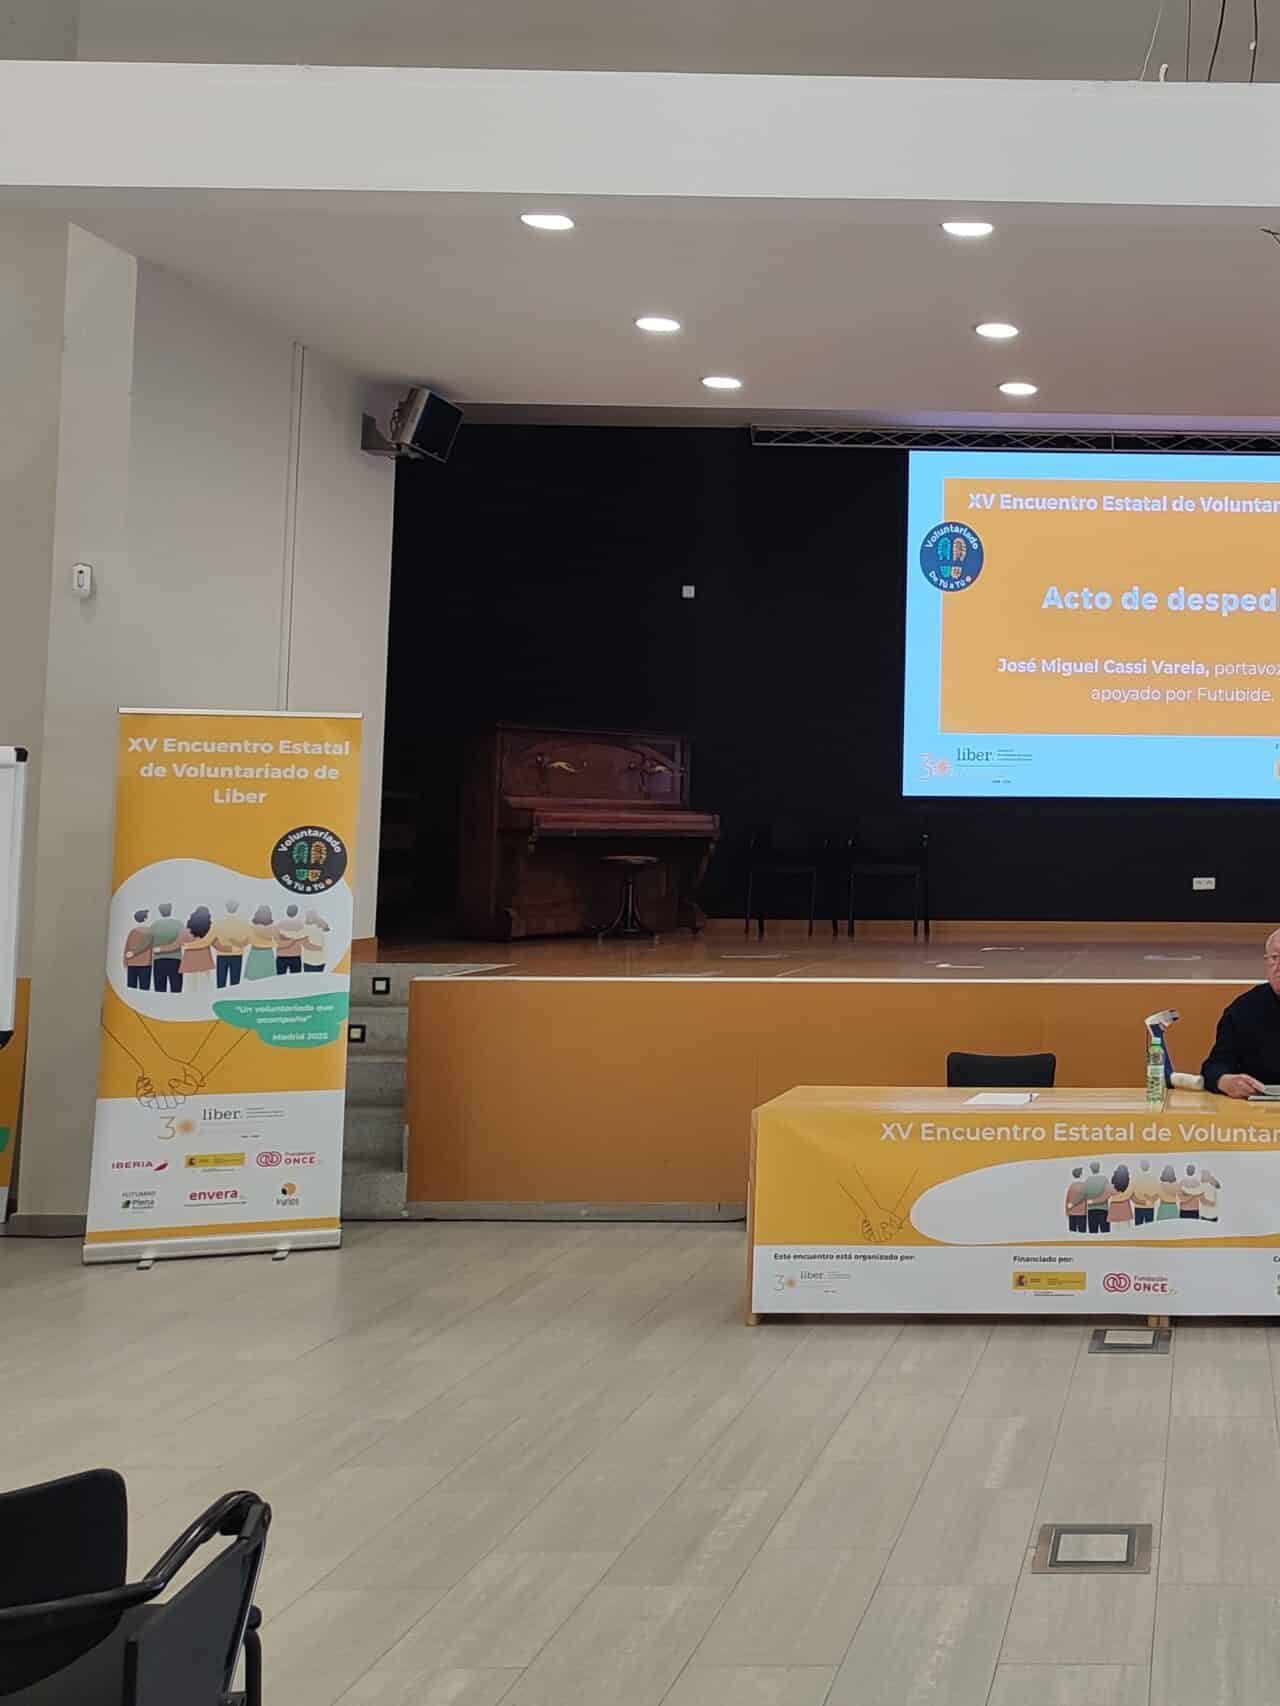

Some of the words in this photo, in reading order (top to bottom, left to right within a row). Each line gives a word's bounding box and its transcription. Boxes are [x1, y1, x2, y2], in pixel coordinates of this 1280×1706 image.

[968, 493, 996, 511] XV
[999, 494, 1098, 512] Encuentro
[1102, 495, 1168, 513] Estatal
[1172, 496, 1196, 514] de
[924, 524, 979, 550] Voluntariado
[1042, 585, 1112, 611] Acto
[1121, 585, 1159, 612] de
[997, 656, 1037, 675] José
[1041, 658, 1099, 679] Miguel
[1103, 658, 1147, 676] Cassi
[1151, 659, 1210, 679] Varela,
[1091, 685, 1162, 705] apoyado
[1165, 688, 1194, 705] por
[1197, 686, 1275, 704] Futubide.
[127, 737, 158, 753] XV
[163, 738, 274, 754] Encuentro
[279, 740, 351, 756] Estatal
[139, 763, 167, 778] de
[172, 764, 309, 780] Voluntariado
[313, 765, 340, 780] de
[213, 788, 267, 805] Liber
[278, 829, 342, 853] Voluntariado
[880, 1123, 913, 1141] XV
[920, 1124, 1046, 1142] Encuentro
[1053, 1123, 1134, 1142] Estatal
[1141, 1124, 1172, 1143] de
[111, 1160, 154, 1170] IBERIA
[284, 1156, 317, 1165] ONCE
[189, 1188, 239, 1201] envera
[854, 1254, 898, 1263] organizado
[1134, 1283, 1168, 1292] ONCE
